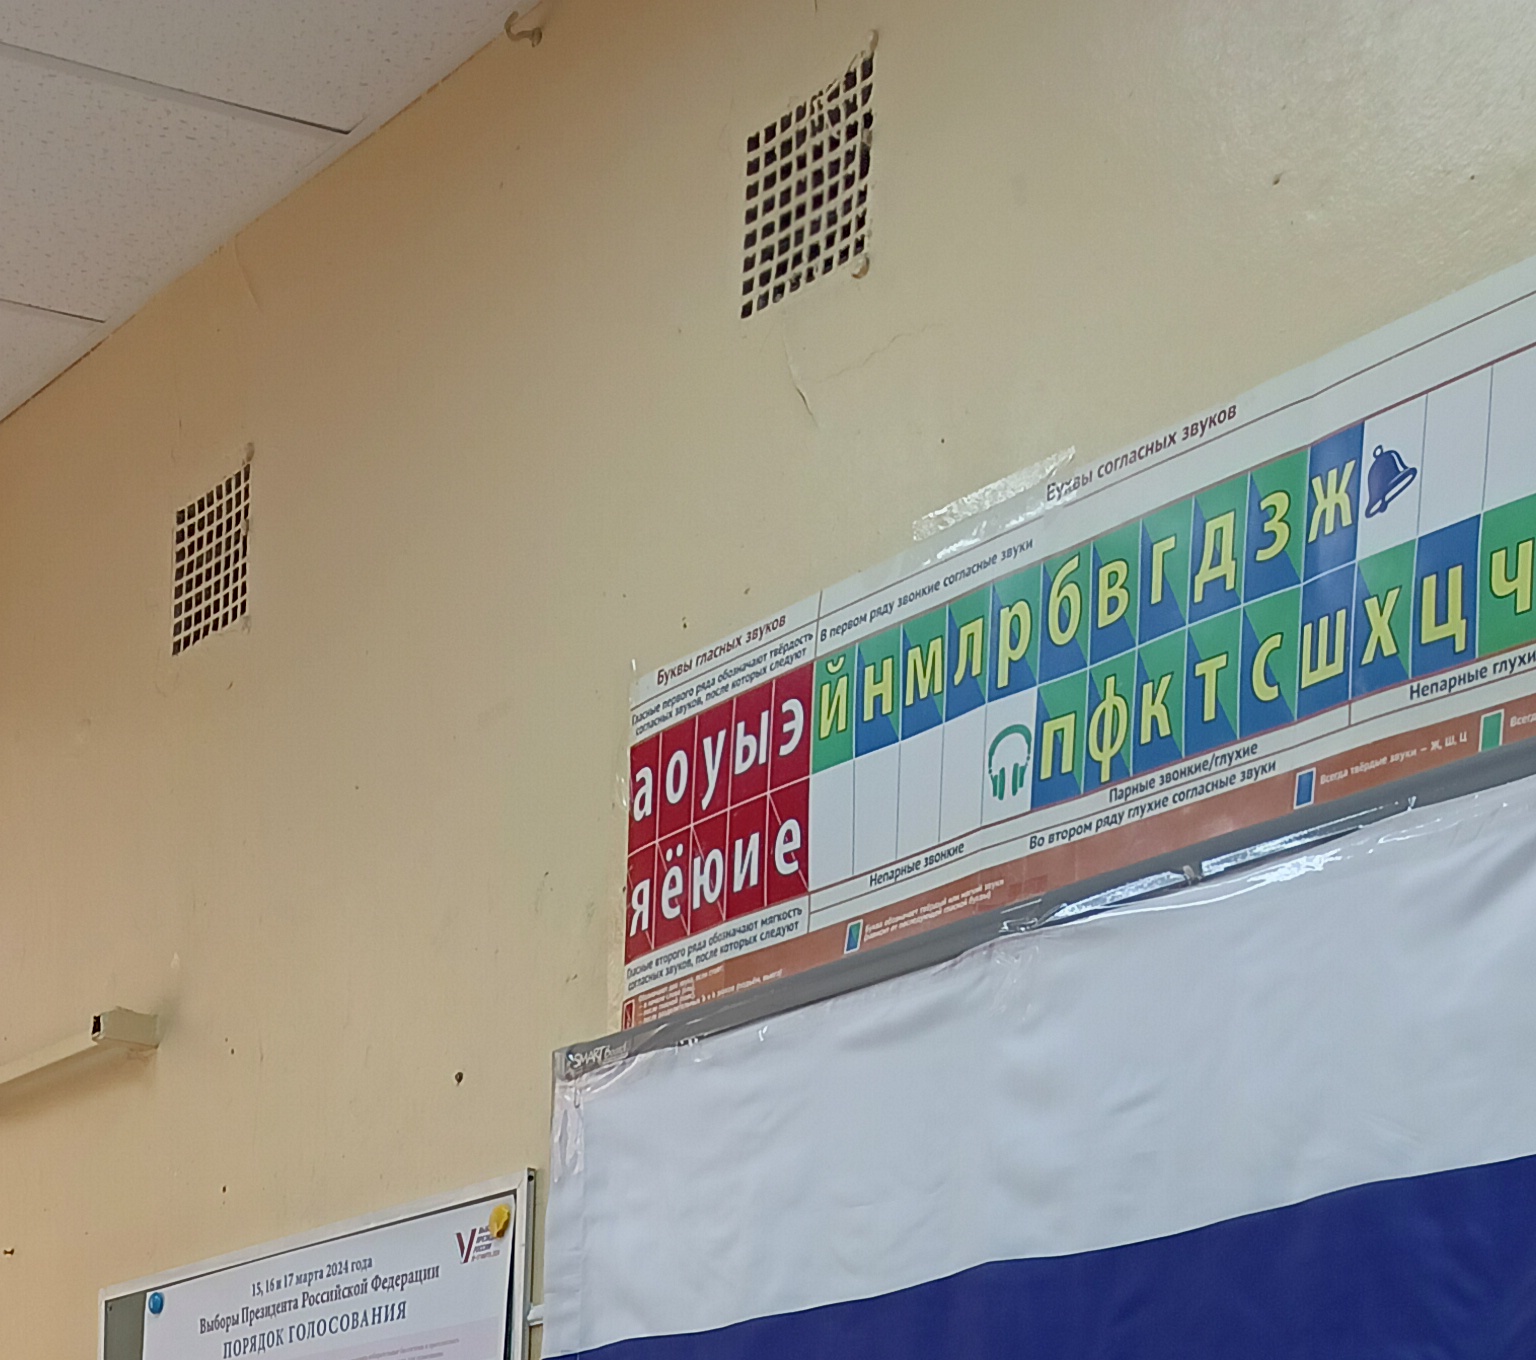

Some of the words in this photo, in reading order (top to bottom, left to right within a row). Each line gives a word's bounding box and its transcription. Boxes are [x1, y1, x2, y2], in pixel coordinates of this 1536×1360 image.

[1047, 470, 1093, 502] Буквы
[1097, 430, 1177, 480] согласных
[1181, 404, 1237, 442] звуков
[819, 655, 849, 740] й
[862, 656, 894, 722] н
[905, 636, 945, 707] м
[954, 617, 985, 686] л
[996, 599, 1032, 689] р
[1047, 554, 1081, 647] б
[1096, 558, 1130, 629] в
[1150, 534, 1177, 605] г
[1193, 509, 1236, 604] д
[1255, 489, 1291, 562] з
[1307, 459, 1356, 543] ж
[820, 628, 827, 644] В
[829, 613, 867, 642] первом
[869, 602, 895, 624] ряду
[897, 578, 941, 608] звонкие
[943, 552, 997, 588] согласные
[1001, 538, 1034, 565] звуки
[657, 659, 692, 686] Буквы
[695, 636, 742, 668] гласных
[746, 615, 786, 643] звуков
[1039, 711, 1076, 781] п
[1088, 676, 1129, 785] ф
[1140, 670, 1174, 745] к
[1194, 651, 1228, 722] т
[1251, 632, 1283, 702] с
[1301, 607, 1347, 690] ш
[1361, 586, 1402, 667] х
[1420, 564, 1467, 653] ц
[1490, 538, 1536, 615] ч
[1410, 666, 1488, 701] Непарные
[1493, 650, 1536, 675] глухи
[1509, 712, 1536, 728] Всегд
[633, 766, 653, 822] а
[665, 749, 689, 805] о
[701, 728, 727, 811] у
[734, 710, 769, 776] ы
[779, 698, 805, 756] э
[1109, 777, 1156, 803] Парные
[1159, 742, 1258, 786] звонкие/глухие
[1029, 834, 1045, 850] Во
[1048, 821, 1092, 845] втором
[1095, 810, 1125, 833] ряду
[1127, 797, 1169, 819] глухие
[1172, 773, 1236, 804] согласные
[1239, 760, 1276, 783] звуки
[629, 878, 651, 937] я
[661, 843, 684, 920] ё
[692, 848, 724, 910] ю
[733, 831, 760, 893] и
[774, 818, 802, 876] е
[869, 858, 921, 888] Непарные
[923, 842, 965, 869] звонкие
[199, 1312, 239, 1335] Выборы
[241, 1296, 299, 1326] Президента
[301, 1279, 368, 1309] Российской
[371, 1265, 440, 1293] Федерации
[252, 1282, 263, 1297] 15,
[265, 1279, 275, 1293] 16
[284, 1274, 294, 1289] 17
[295, 1268, 324, 1288] марта
[326, 1259, 349, 1278] 2024
[351, 1257, 373, 1274] года
[223, 1328, 284, 1360] ПОРЯДОК
[288, 1301, 407, 1344] ГОЛОСОВАНИЯ
